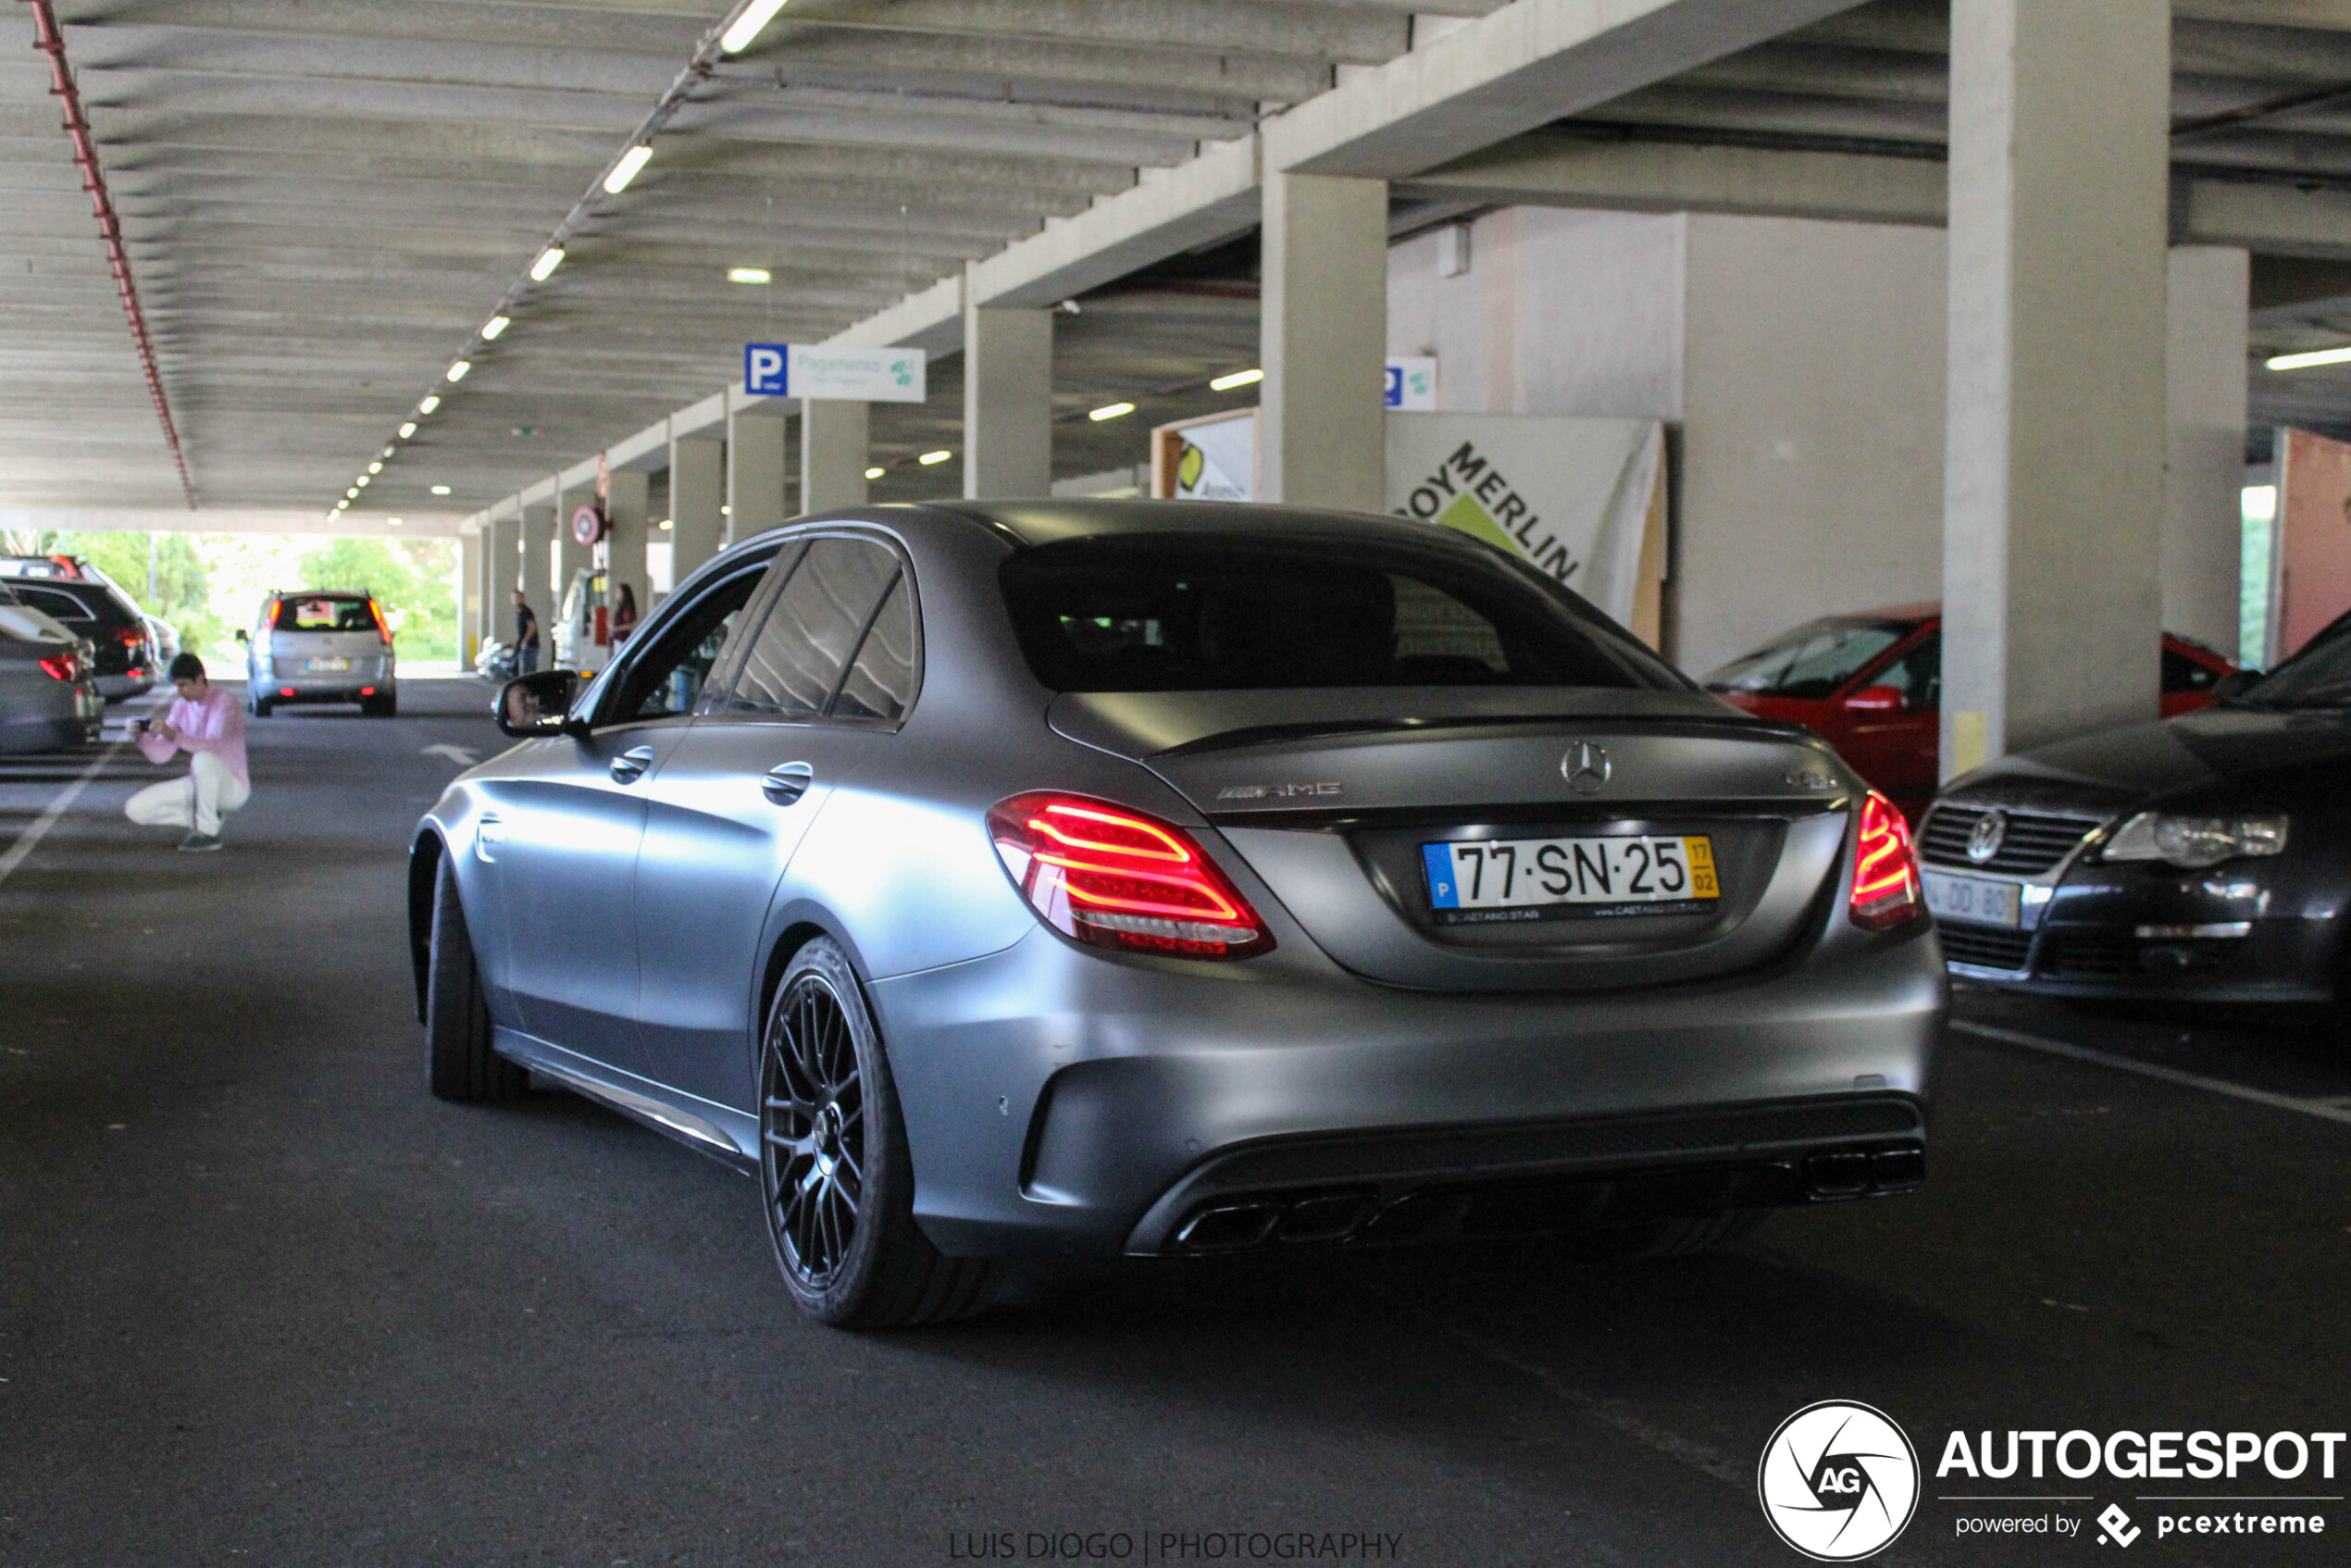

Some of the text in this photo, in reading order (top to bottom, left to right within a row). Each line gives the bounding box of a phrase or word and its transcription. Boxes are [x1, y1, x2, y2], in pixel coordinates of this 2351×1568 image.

[750, 348, 782, 391] P
[1393, 441, 1579, 581] OY MERLIN
[1692, 843, 1707, 860] 17
[1438, 882, 1449, 898] P
[1694, 874, 1714, 890] 02
